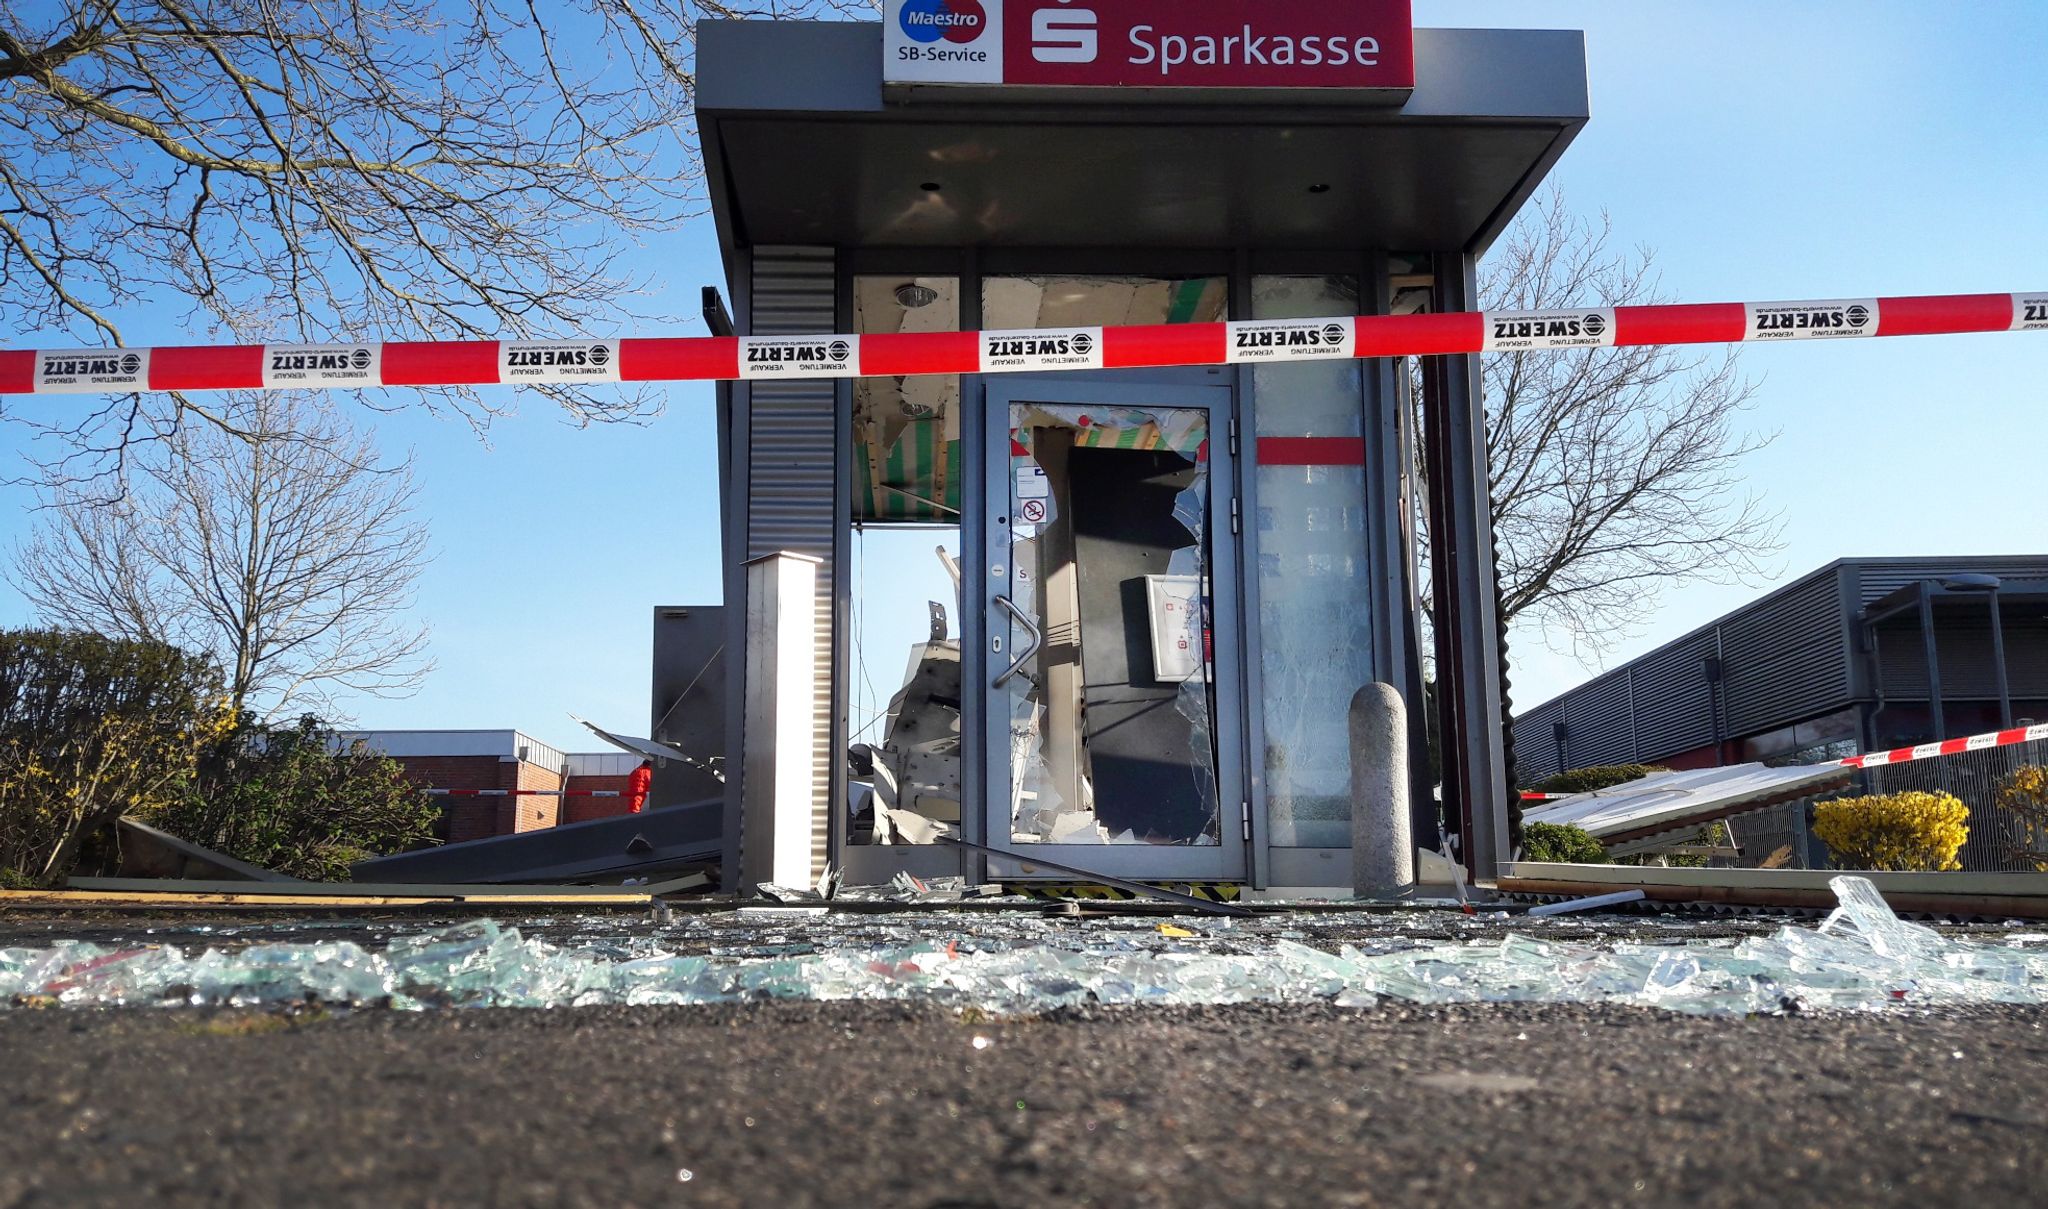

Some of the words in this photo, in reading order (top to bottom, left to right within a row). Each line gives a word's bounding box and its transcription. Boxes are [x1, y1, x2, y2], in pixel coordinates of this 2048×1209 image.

[908, 11, 978, 26] Maestro
[898, 46, 987, 62] SB-Service
[1128, 25, 1380, 74] Sparkasse
[1757, 312, 1843, 329] SWERTZ
[1494, 321, 1580, 338] SWERTZ
[1237, 331, 1319, 347] SWERTZ
[1550, 338, 1600, 346] VERMIETUNG
[748, 347, 826, 361] SWERTZ
[989, 340, 1068, 355] SWERTZ
[1238, 349, 1274, 357] VERKAUF
[1290, 347, 1341, 355] VERMIETUNG
[273, 355, 348, 369] SWERTZ
[508, 351, 586, 365] SWERTZ
[44, 360, 118, 374] SWERTZ
